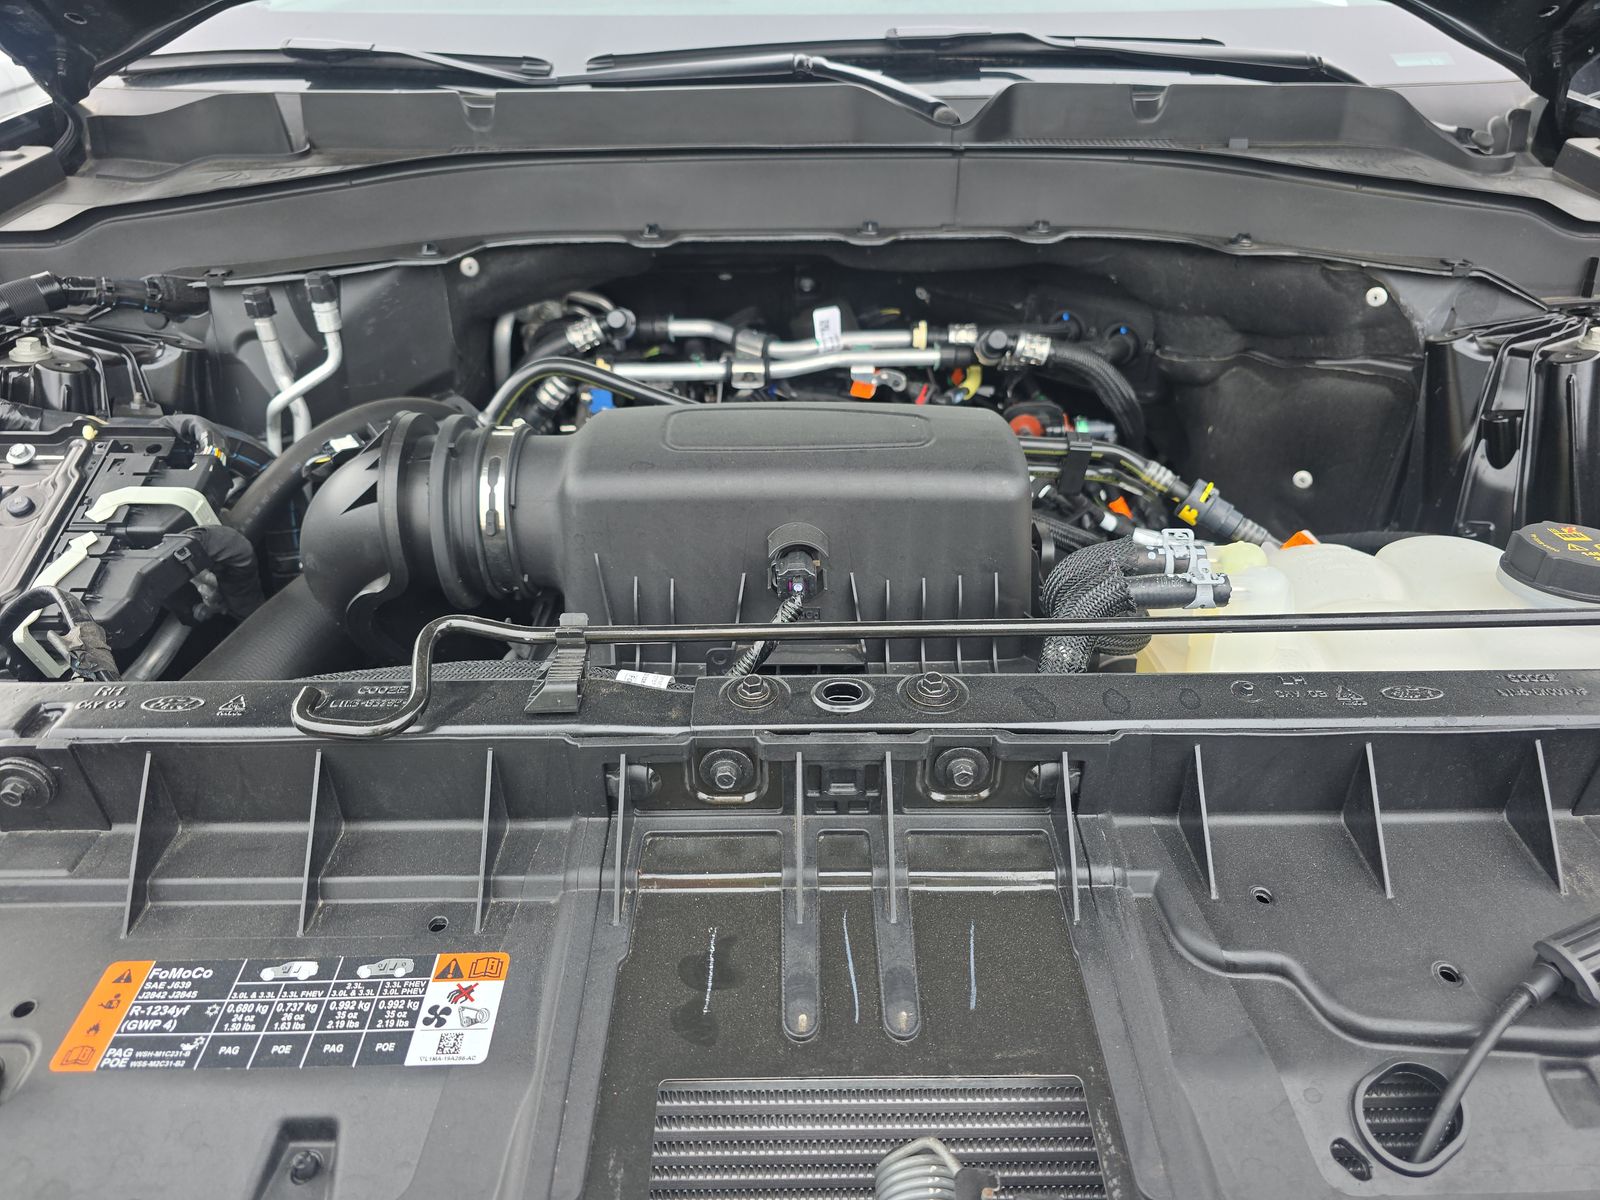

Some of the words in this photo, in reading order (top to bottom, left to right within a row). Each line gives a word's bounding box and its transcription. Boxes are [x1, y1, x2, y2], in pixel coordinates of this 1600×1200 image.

[149, 967, 214, 980] FoMoCo
[144, 981, 167, 989] SAE
[167, 981, 192, 989] J639
[138, 991, 168, 999] J2842
[168, 991, 198, 999] J2845
[301, 990, 324, 998] FHEV
[227, 1003, 255, 1013] 0.680
[256, 1003, 269, 1014] kg
[276, 1003, 304, 1012] 0.737
[305, 1002, 318, 1013] kg
[329, 1001, 357, 1011] 0.992
[358, 1001, 371, 1011] kg
[379, 1000, 406, 1010] 0.992
[407, 999, 420, 1010] kg
[129, 1005, 191, 1018] R-1234yf
[335, 1011, 348, 1019] 35
[385, 1010, 396, 1018] 35
[232, 1014, 243, 1022] 24
[281, 1013, 293, 1021] 26
[121, 1020, 162, 1033] (GWP
[163, 1020, 177, 1032] 4)
[224, 1023, 241, 1031] 1.50
[242, 1023, 256, 1031] lbs
[274, 1022, 291, 1030] 1.63
[292, 1022, 306, 1030] lbs
[326, 1020, 345, 1029] 2.19
[346, 1020, 360, 1028] lbs
[376, 1019, 395, 1028] 2.19
[396, 1019, 410, 1027] lbs
[218, 1046, 240, 1055] PAG
[271, 1045, 292, 1054] POE
[323, 1044, 344, 1053] PAG
[375, 1042, 396, 1052] POE
[106, 1048, 134, 1058] PAG
[100, 1058, 130, 1068] POE
